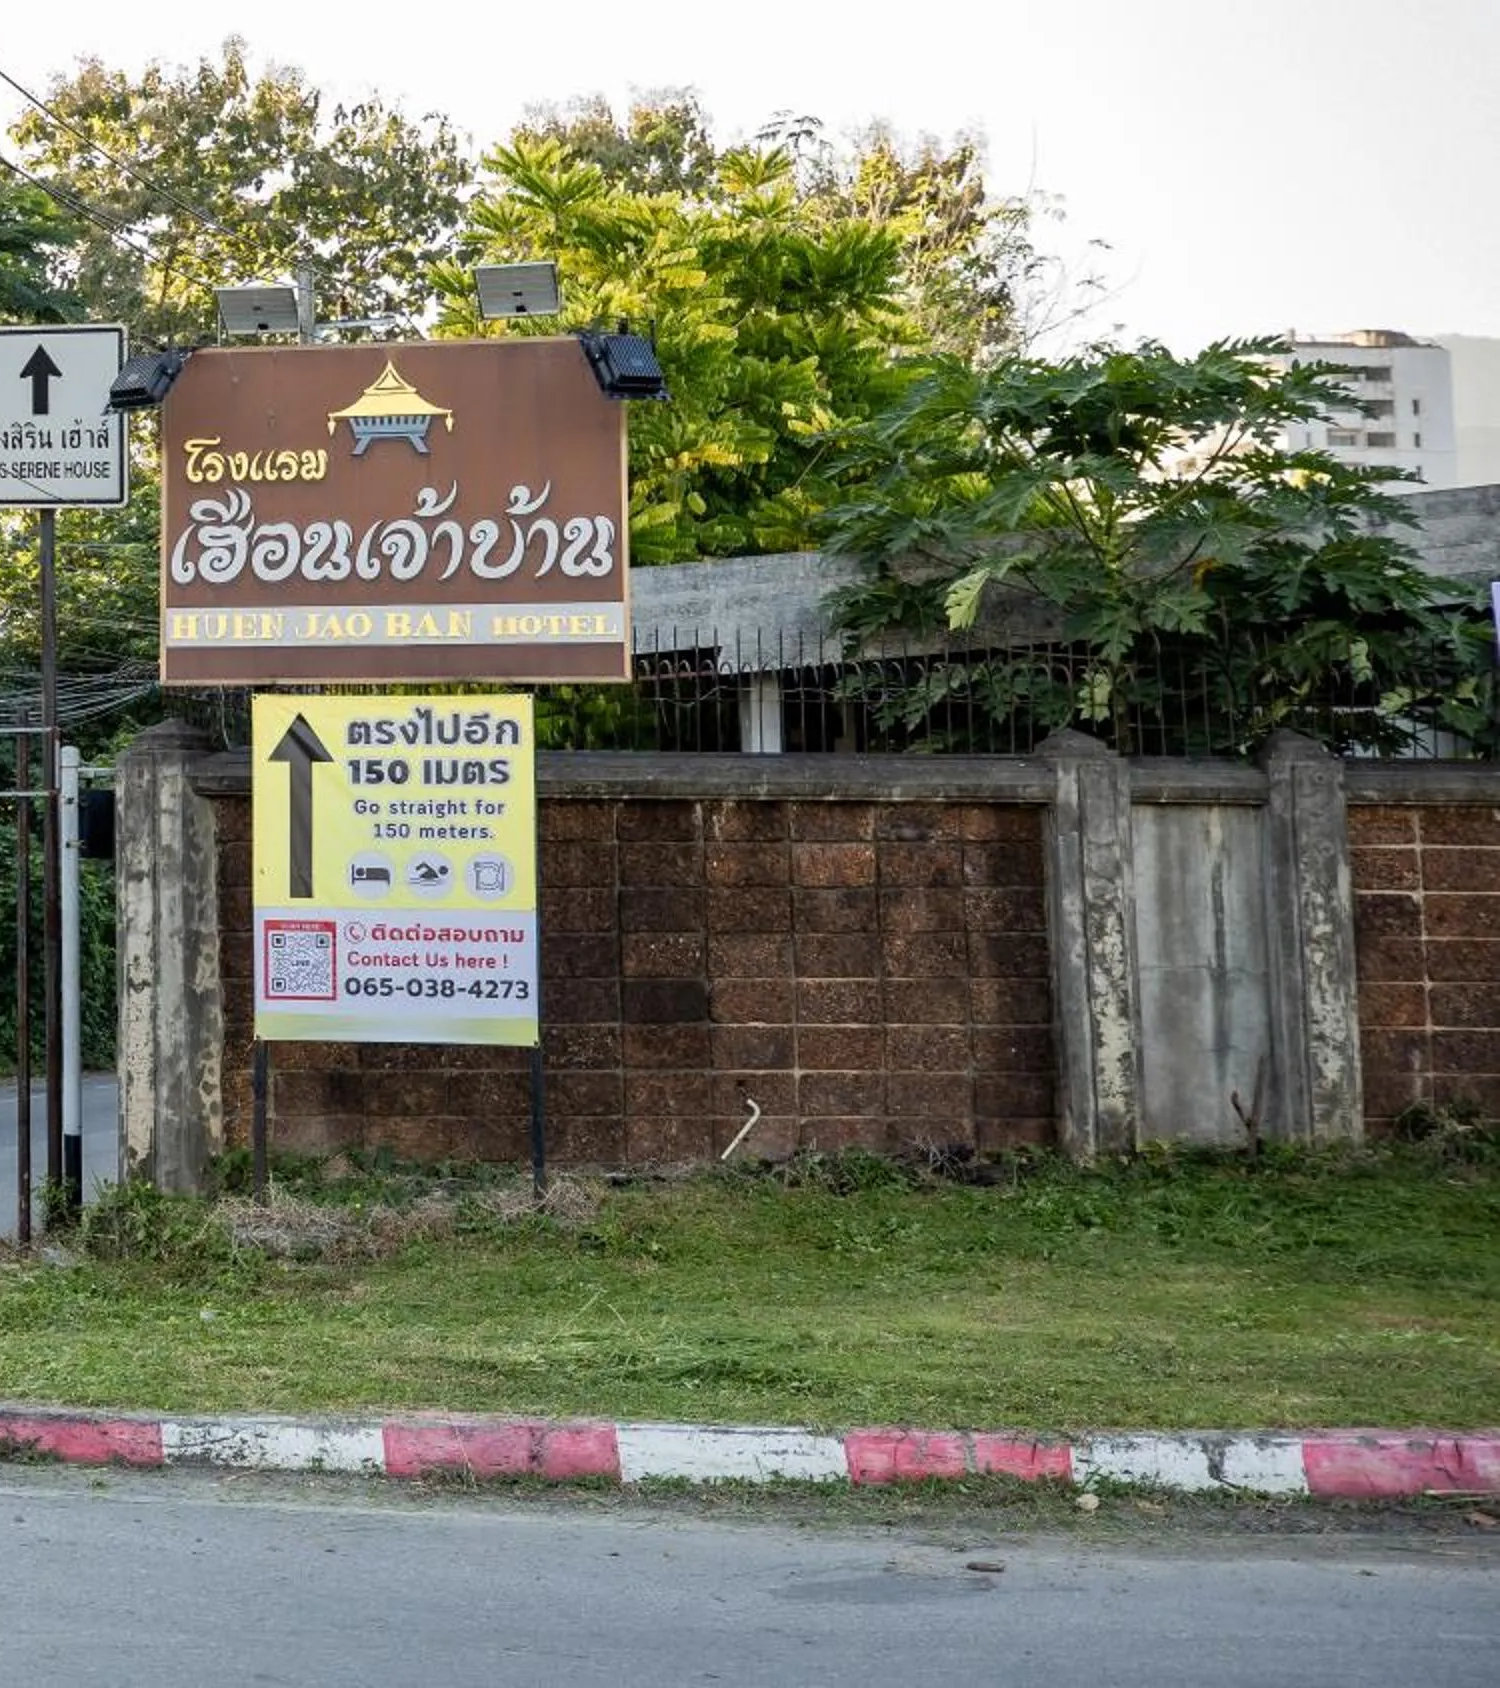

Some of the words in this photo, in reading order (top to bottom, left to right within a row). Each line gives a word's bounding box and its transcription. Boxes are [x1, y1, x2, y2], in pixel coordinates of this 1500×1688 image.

[11, 461, 61, 479] SERENE
[64, 461, 111, 479] HOUSE
[183, 436, 329, 484] โรงแรม
[170, 479, 617, 585] เฮือนเจ้าบ้าน
[171, 612, 284, 642] HUEN
[295, 611, 373, 641] JAO
[386, 610, 473, 640] BAN
[492, 613, 618, 637] HOTEL
[346, 706, 520, 746] ตรงไปอีก
[347, 759, 410, 785] 150
[422, 758, 510, 786] เมตร
[354, 799, 381, 815] Go
[389, 798, 468, 819] straight
[474, 799, 505, 816] for
[373, 823, 410, 839] 150
[418, 824, 495, 840] meters.
[371, 922, 525, 944] ติดต่อสอบถาม
[347, 951, 419, 968] Contact
[425, 952, 449, 969] Us
[455, 952, 497, 969] here
[345, 976, 530, 1000] 065-038-4273
